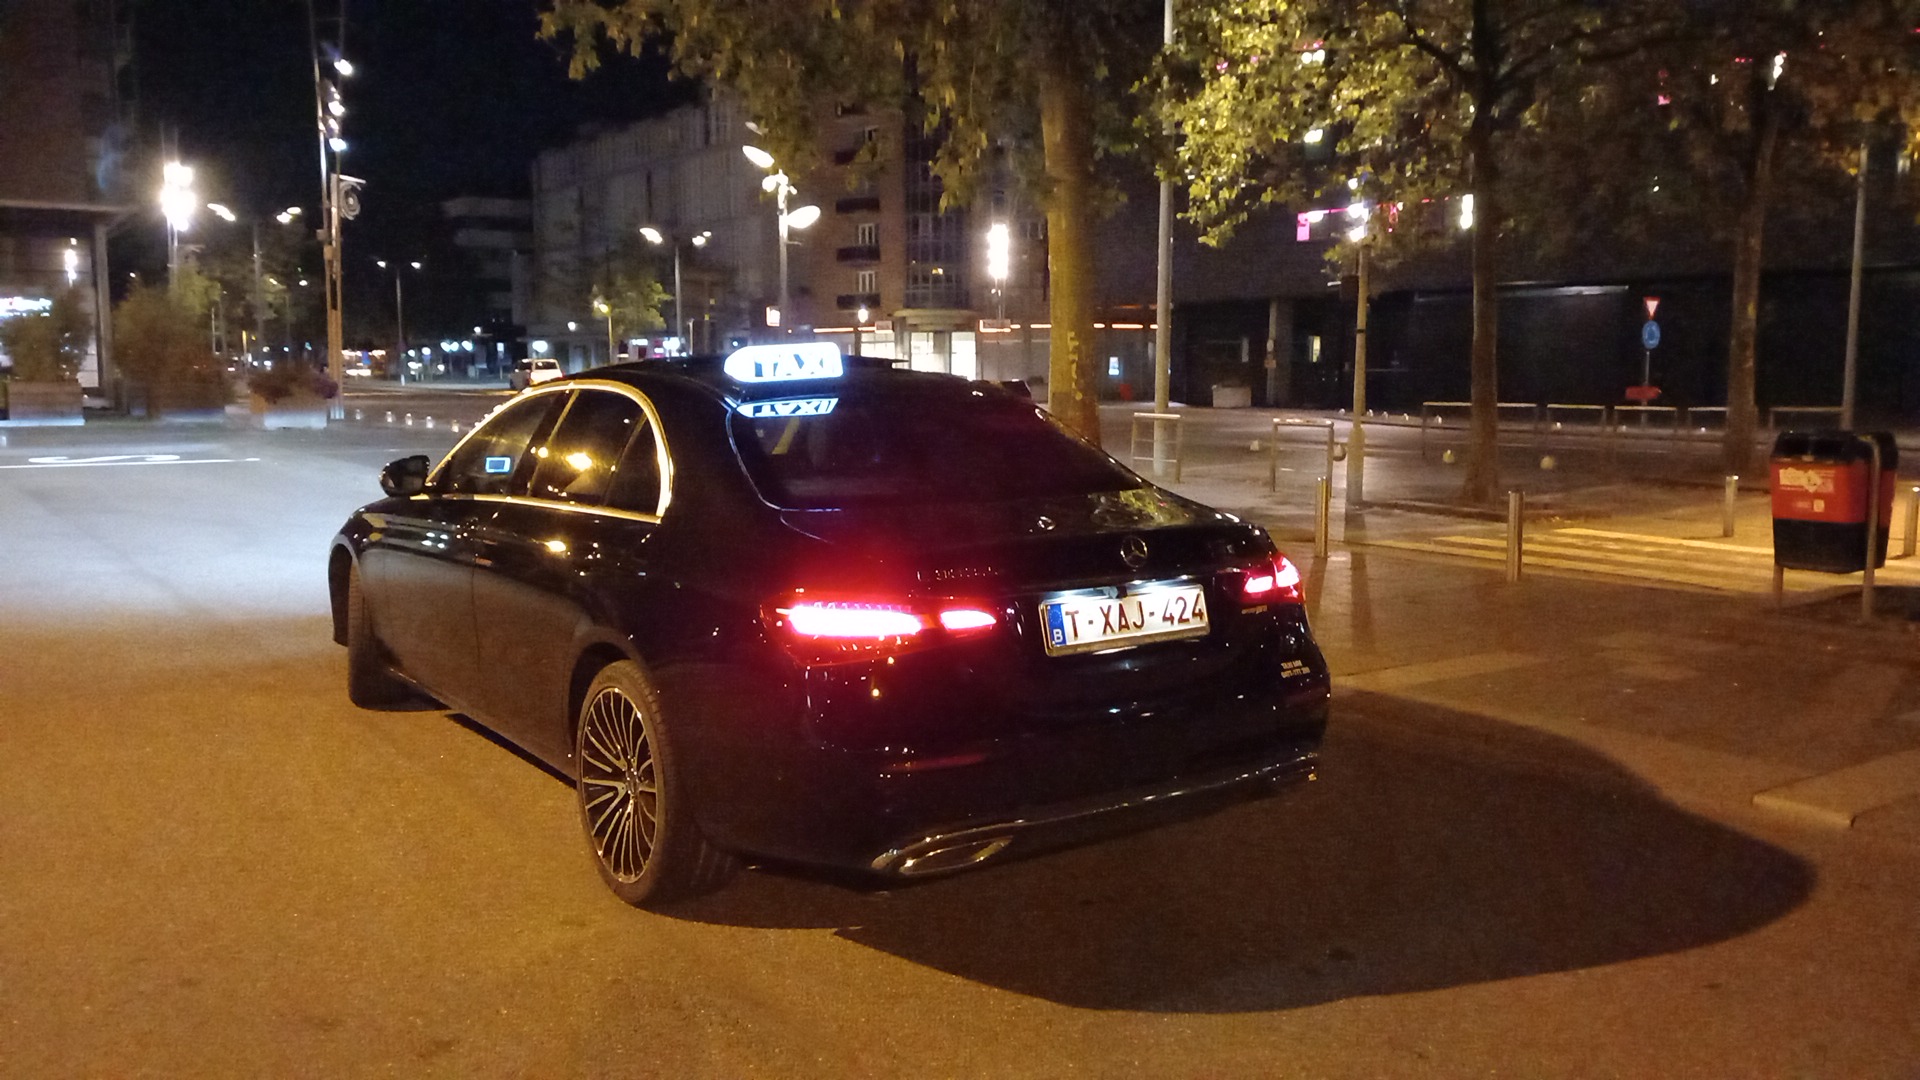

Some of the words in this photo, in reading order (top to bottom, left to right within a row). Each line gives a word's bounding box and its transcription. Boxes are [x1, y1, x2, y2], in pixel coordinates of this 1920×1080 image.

[753, 350, 835, 377] TAXI
[1064, 592, 1204, 641] T-XAJ-424
[1053, 628, 1064, 643] B
